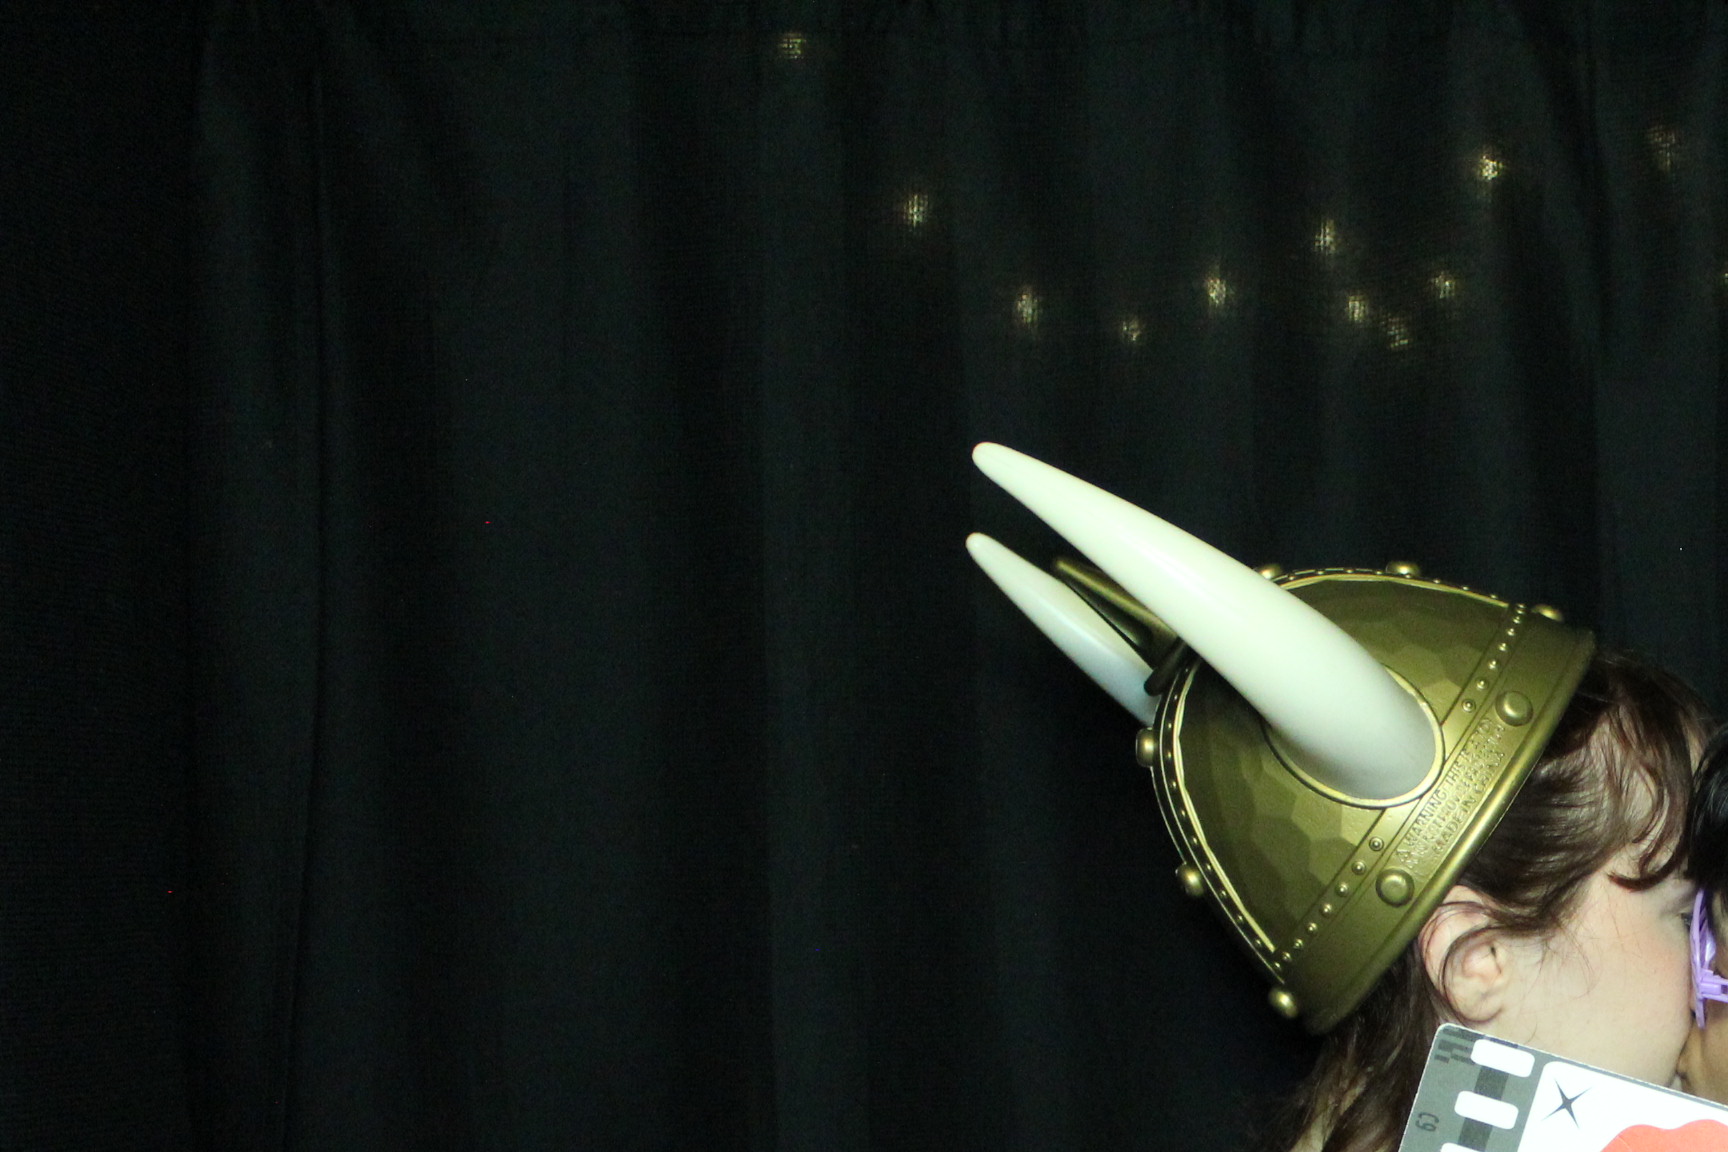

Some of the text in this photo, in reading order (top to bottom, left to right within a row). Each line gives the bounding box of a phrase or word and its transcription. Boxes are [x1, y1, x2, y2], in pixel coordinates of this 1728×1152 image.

[1402, 787, 1448, 847] WARNING
[1442, 760, 1466, 786] THIS
[1429, 748, 1507, 856] MADE IN CHINA
